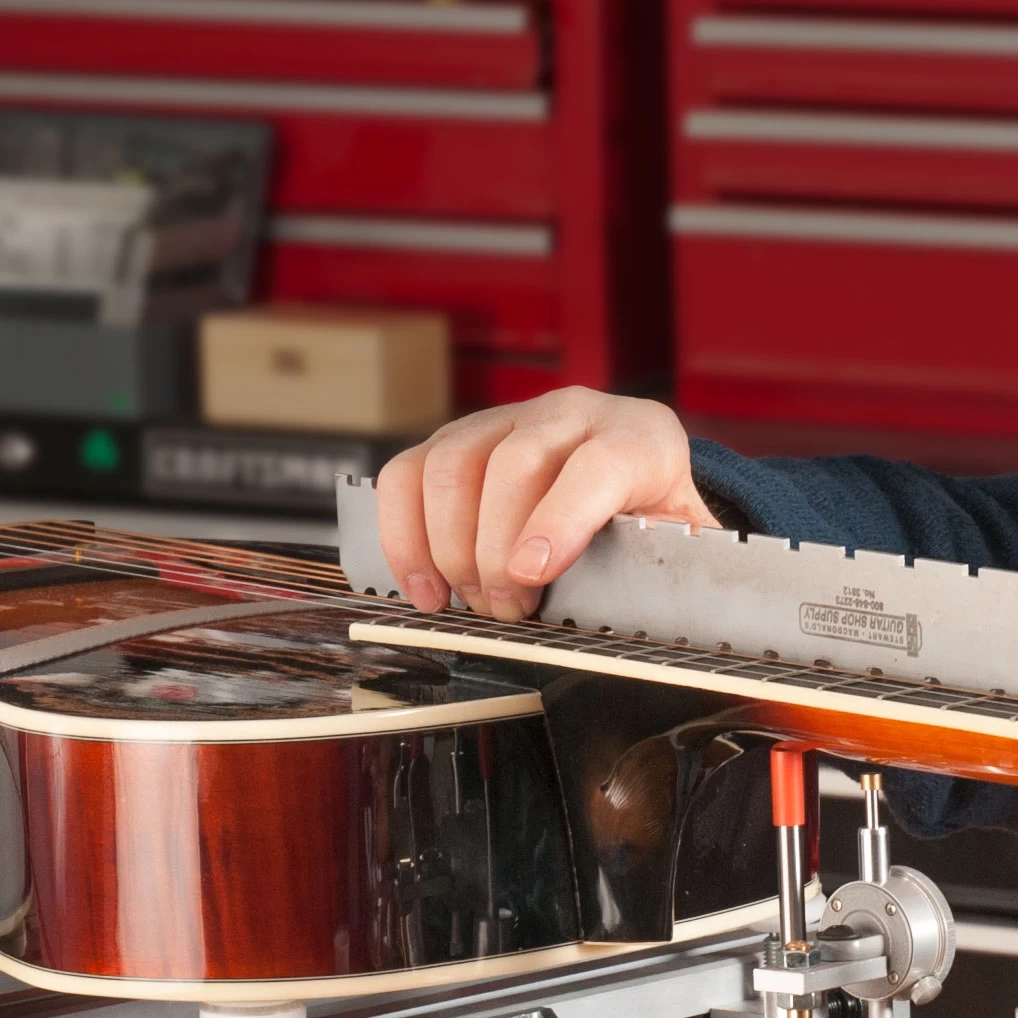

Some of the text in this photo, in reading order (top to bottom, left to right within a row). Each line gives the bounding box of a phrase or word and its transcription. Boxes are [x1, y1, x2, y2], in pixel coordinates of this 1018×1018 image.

[804, 607, 904, 634] GUITAR SHOP SUPPLY
[804, 621, 904, 645] STEWART MACDONALD'S
